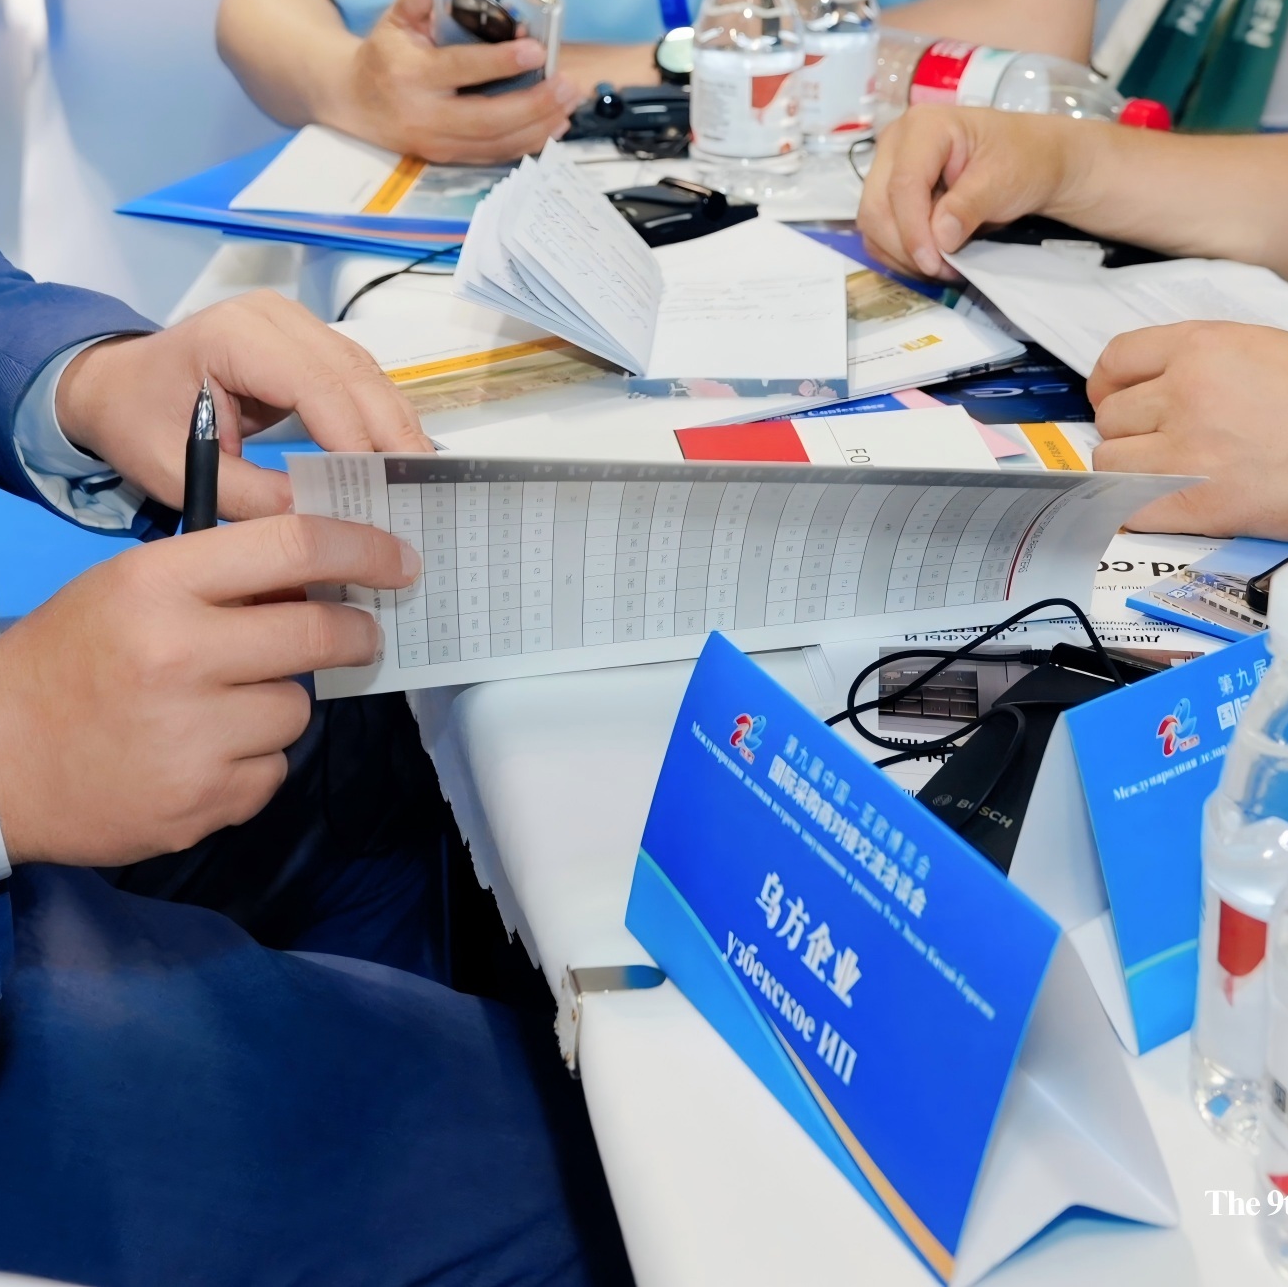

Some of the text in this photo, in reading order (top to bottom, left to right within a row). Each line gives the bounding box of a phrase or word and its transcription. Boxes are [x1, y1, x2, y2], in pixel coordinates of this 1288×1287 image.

[722, 930, 858, 1086] узбекское ИП
[756, 871, 862, 1008] 乌方企业
